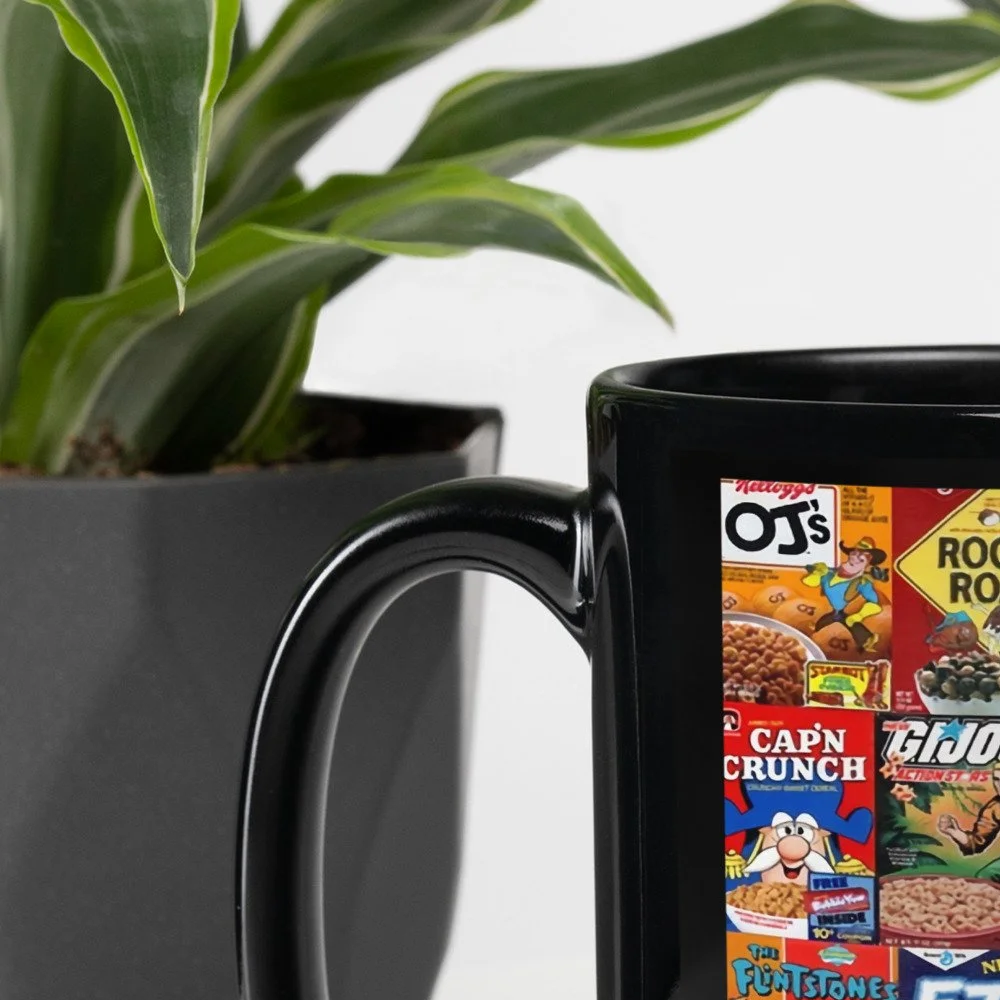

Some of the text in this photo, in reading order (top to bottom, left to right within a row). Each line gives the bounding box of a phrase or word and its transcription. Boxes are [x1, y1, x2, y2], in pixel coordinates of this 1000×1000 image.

[750, 722, 846, 754] CAP'N
[724, 755, 866, 782] CRUNCH
[747, 943, 780, 961] THE
